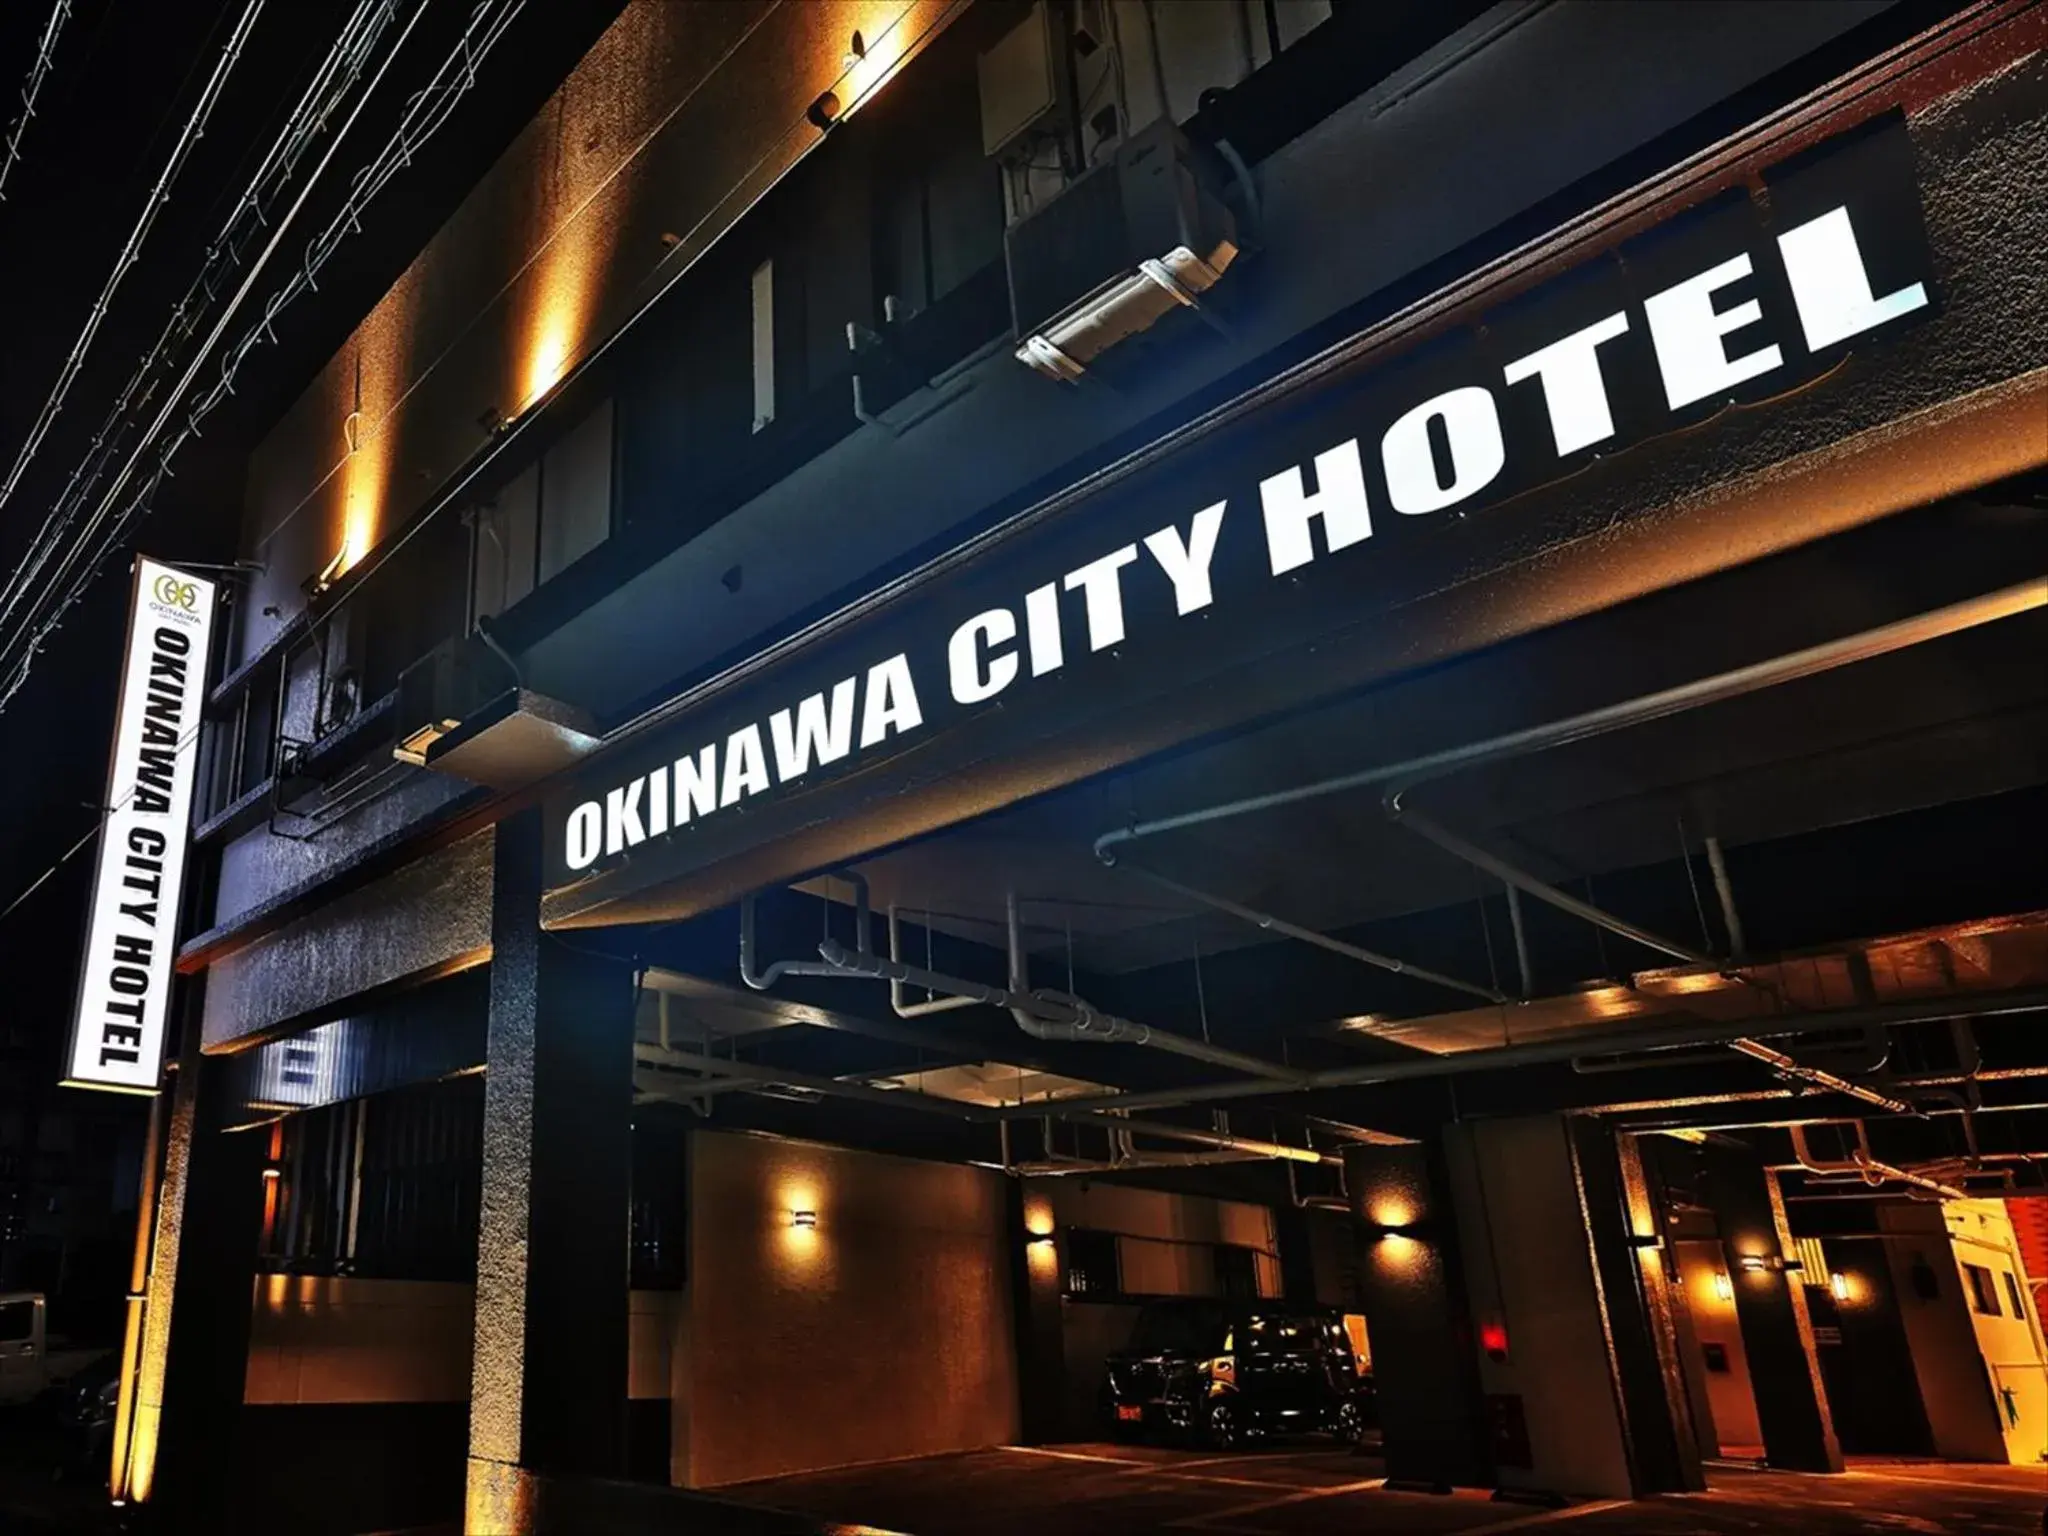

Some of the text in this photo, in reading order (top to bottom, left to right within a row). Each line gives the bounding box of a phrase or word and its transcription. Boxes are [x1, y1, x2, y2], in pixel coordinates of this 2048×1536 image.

[566, 205, 1929, 870] OKINAWA CITY HOTEL
[132, 626, 191, 814] OKINAWA
[119, 826, 167, 929] CITY
[99, 934, 153, 1068] HOTEL
